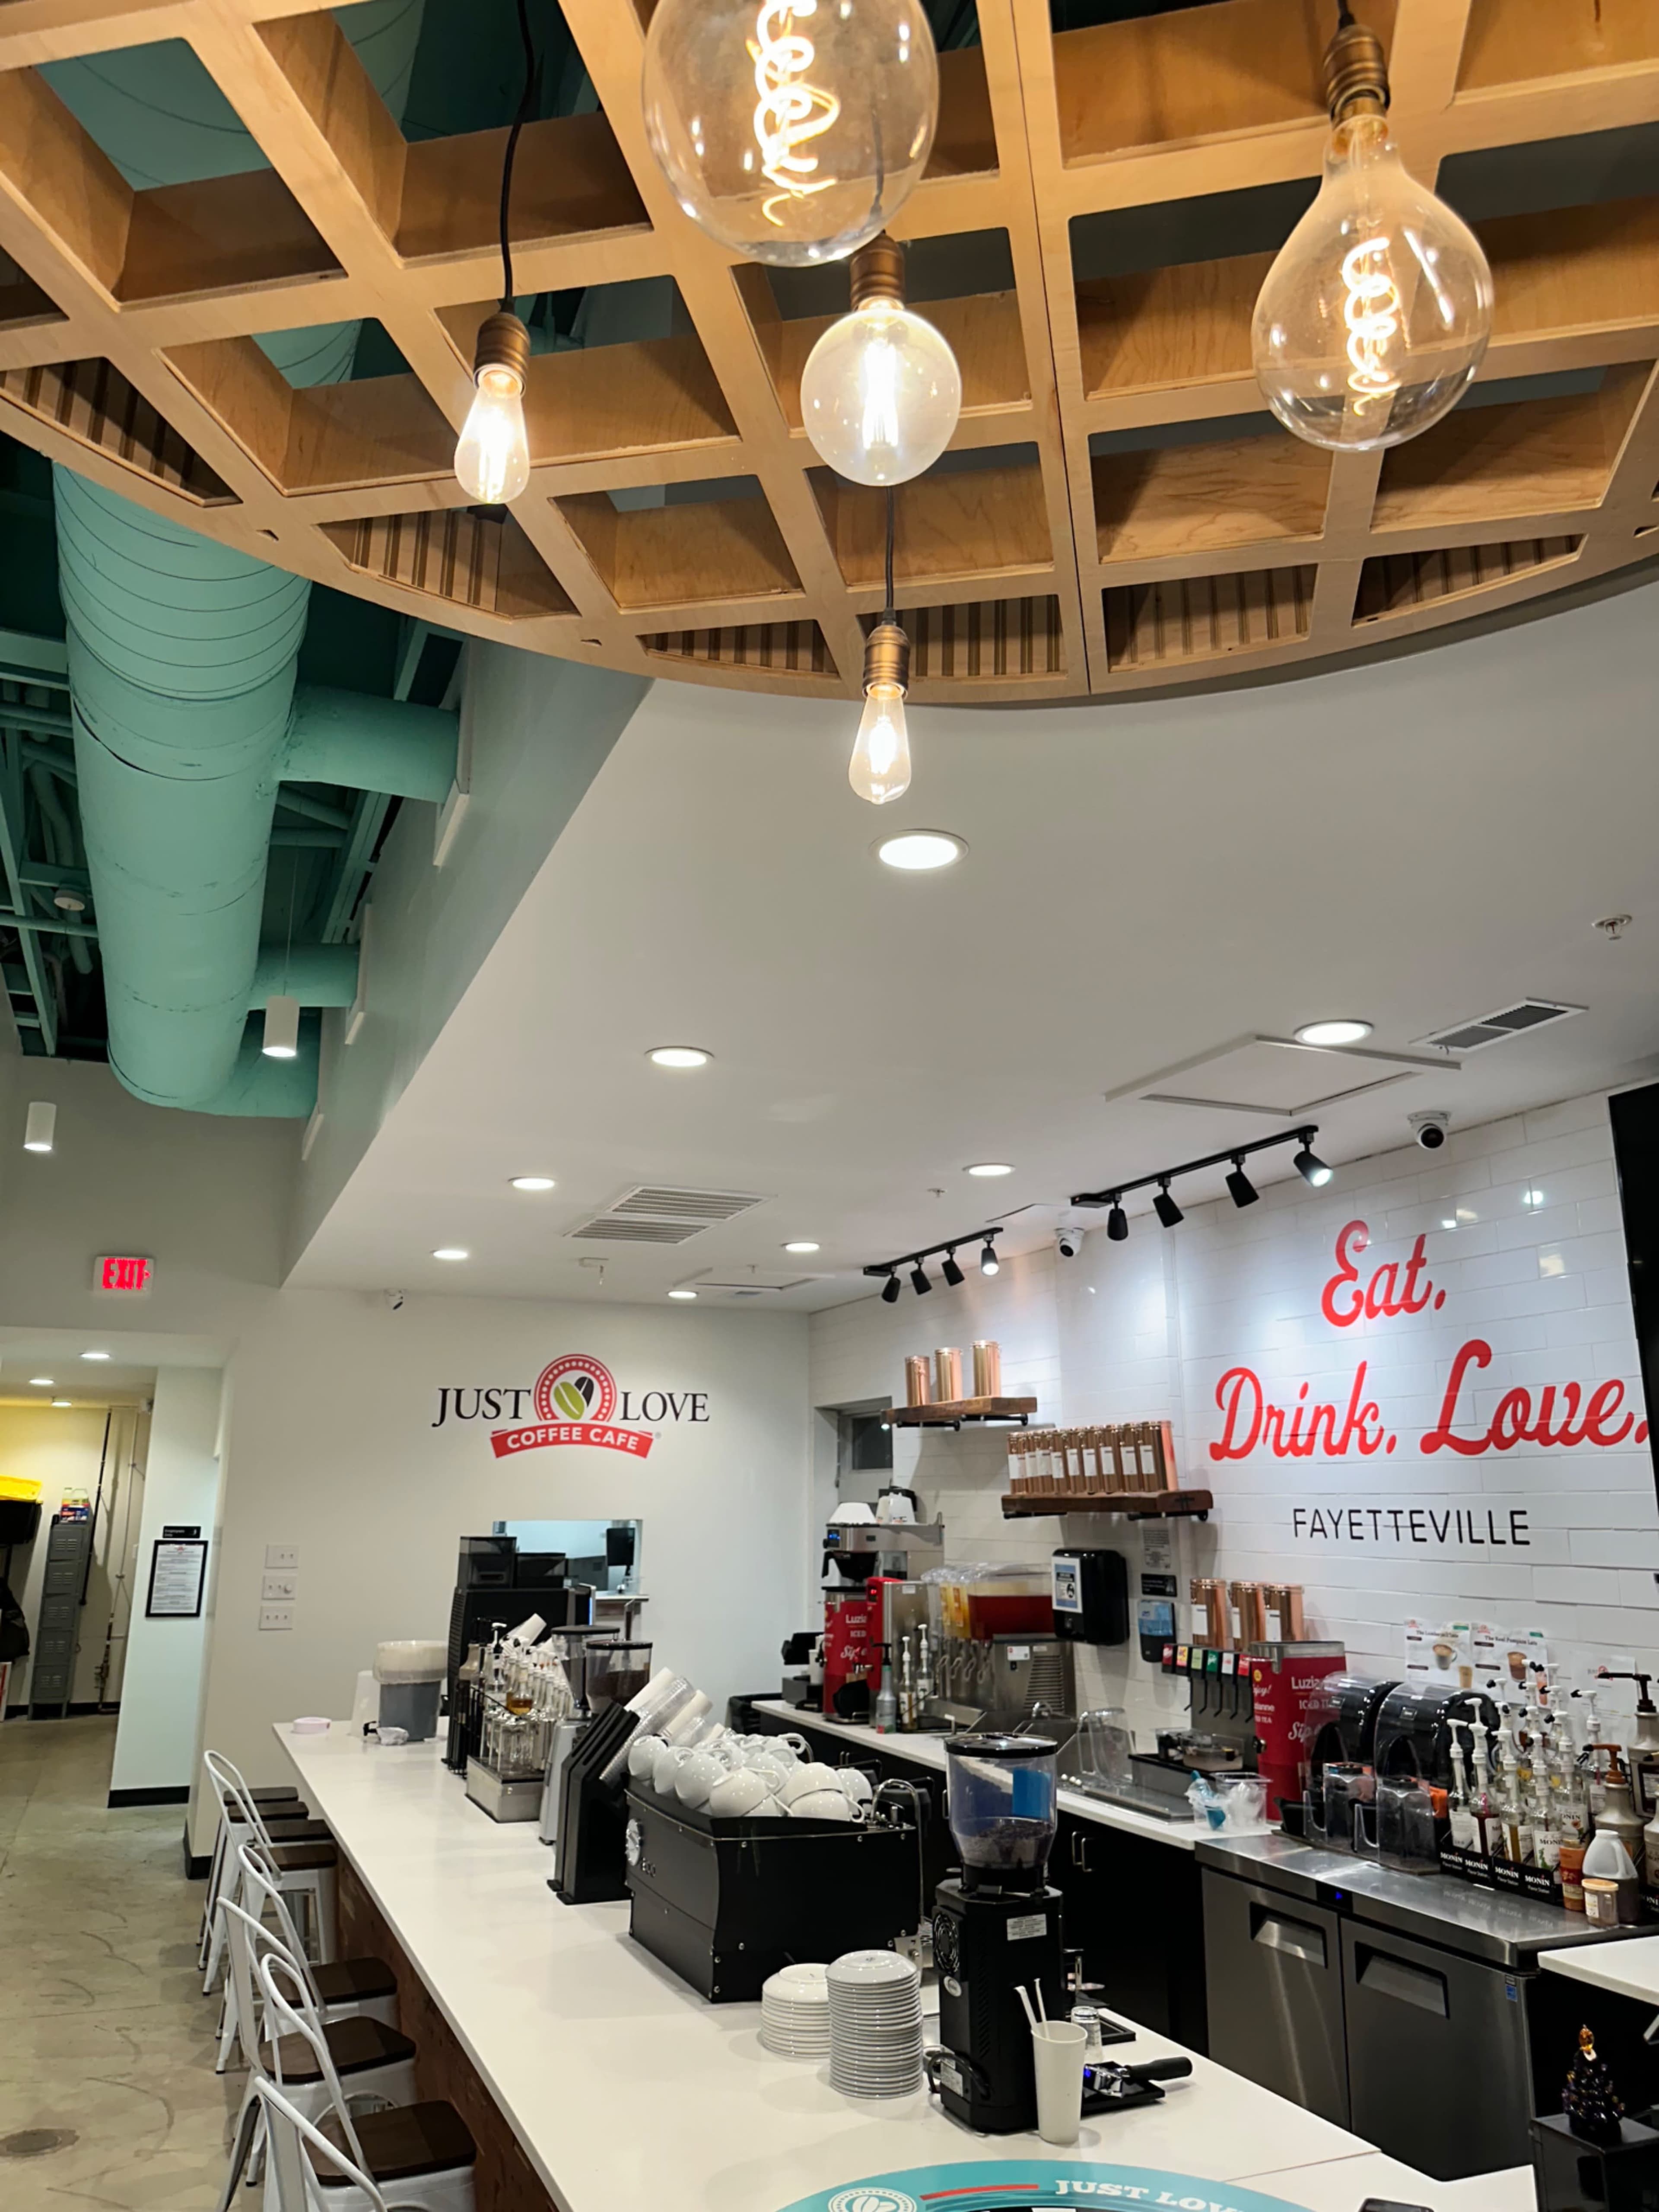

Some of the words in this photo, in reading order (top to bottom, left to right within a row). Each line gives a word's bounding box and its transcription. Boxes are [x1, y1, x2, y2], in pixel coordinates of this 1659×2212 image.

[102, 1258, 148, 1290] EXIT
[1321, 1220, 1446, 1327] Eat.
[431, 1387, 531, 1428] JUST
[619, 1391, 710, 1422] LOVE
[1209, 1360, 1397, 1461] Drink.
[1420, 1338, 1649, 1456] Love.
[506, 1427, 582, 1449] COFFEE
[589, 1428, 639, 1450] CAFE
[1293, 1508, 1531, 1545] FAYETTEVILLE
[1440, 1852, 1463, 1863] MONIN
[1465, 1859, 1488, 1871] MONIN
[1495, 1866, 1519, 1878] MONIN
[1524, 1874, 1551, 1886] MONIN
[1055, 2180, 1149, 2199] JUST
[1155, 2191, 1244, 2212] LOV
